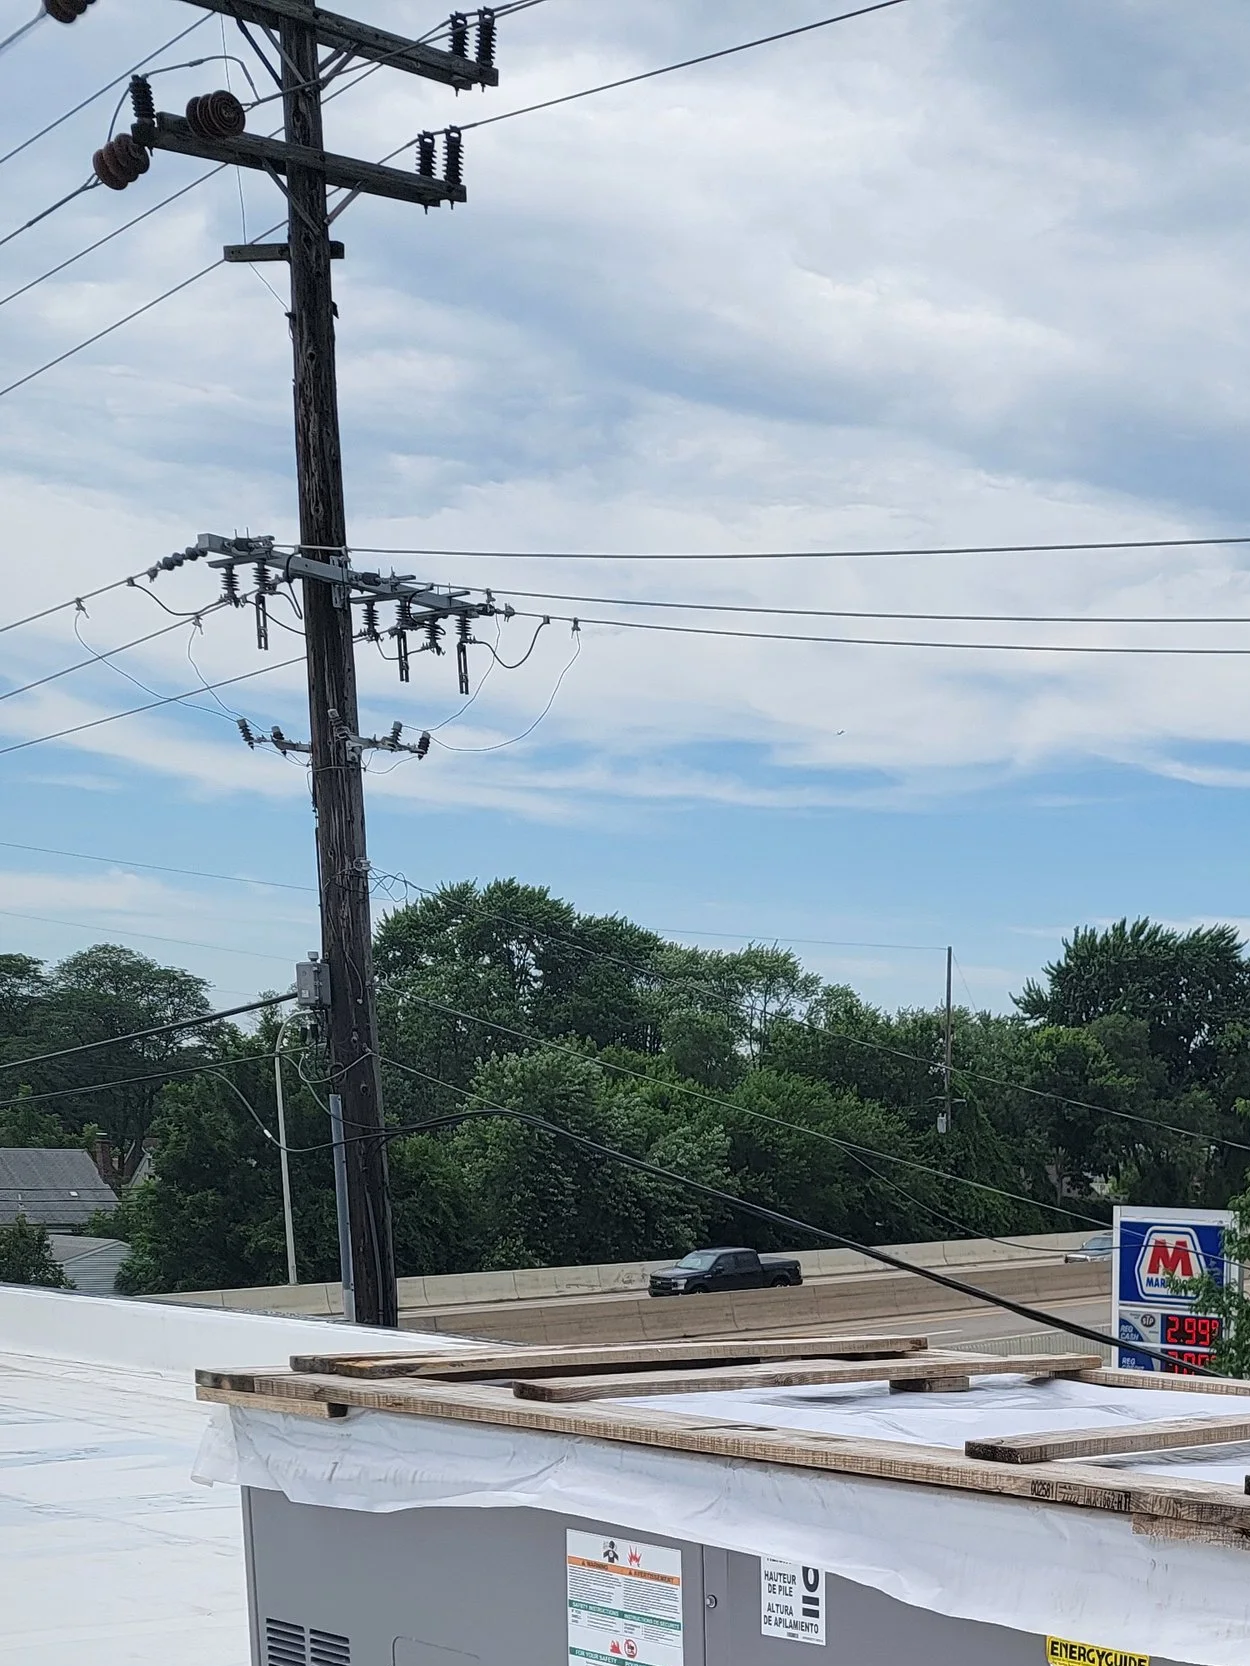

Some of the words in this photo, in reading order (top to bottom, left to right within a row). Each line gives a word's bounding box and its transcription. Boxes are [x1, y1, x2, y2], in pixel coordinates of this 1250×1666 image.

[1142, 1316, 1154, 1326] STP
[1120, 1325, 1133, 1333] REG
[1120, 1332, 1140, 1341] CASH
[1122, 1358, 1135, 1366] REG
[764, 1570, 797, 1586] HAUTEUR
[768, 1584, 777, 1594] DE
[778, 1585, 793, 1597] PILE
[767, 1602, 794, 1616] ALTURA
[763, 1614, 772, 1625] DE
[774, 1617, 819, 1634] APILAMIENTO
[575, 1649, 585, 1657] FOR
[586, 1652, 599, 1660] YOUR
[599, 1655, 617, 1664] SAFETY
